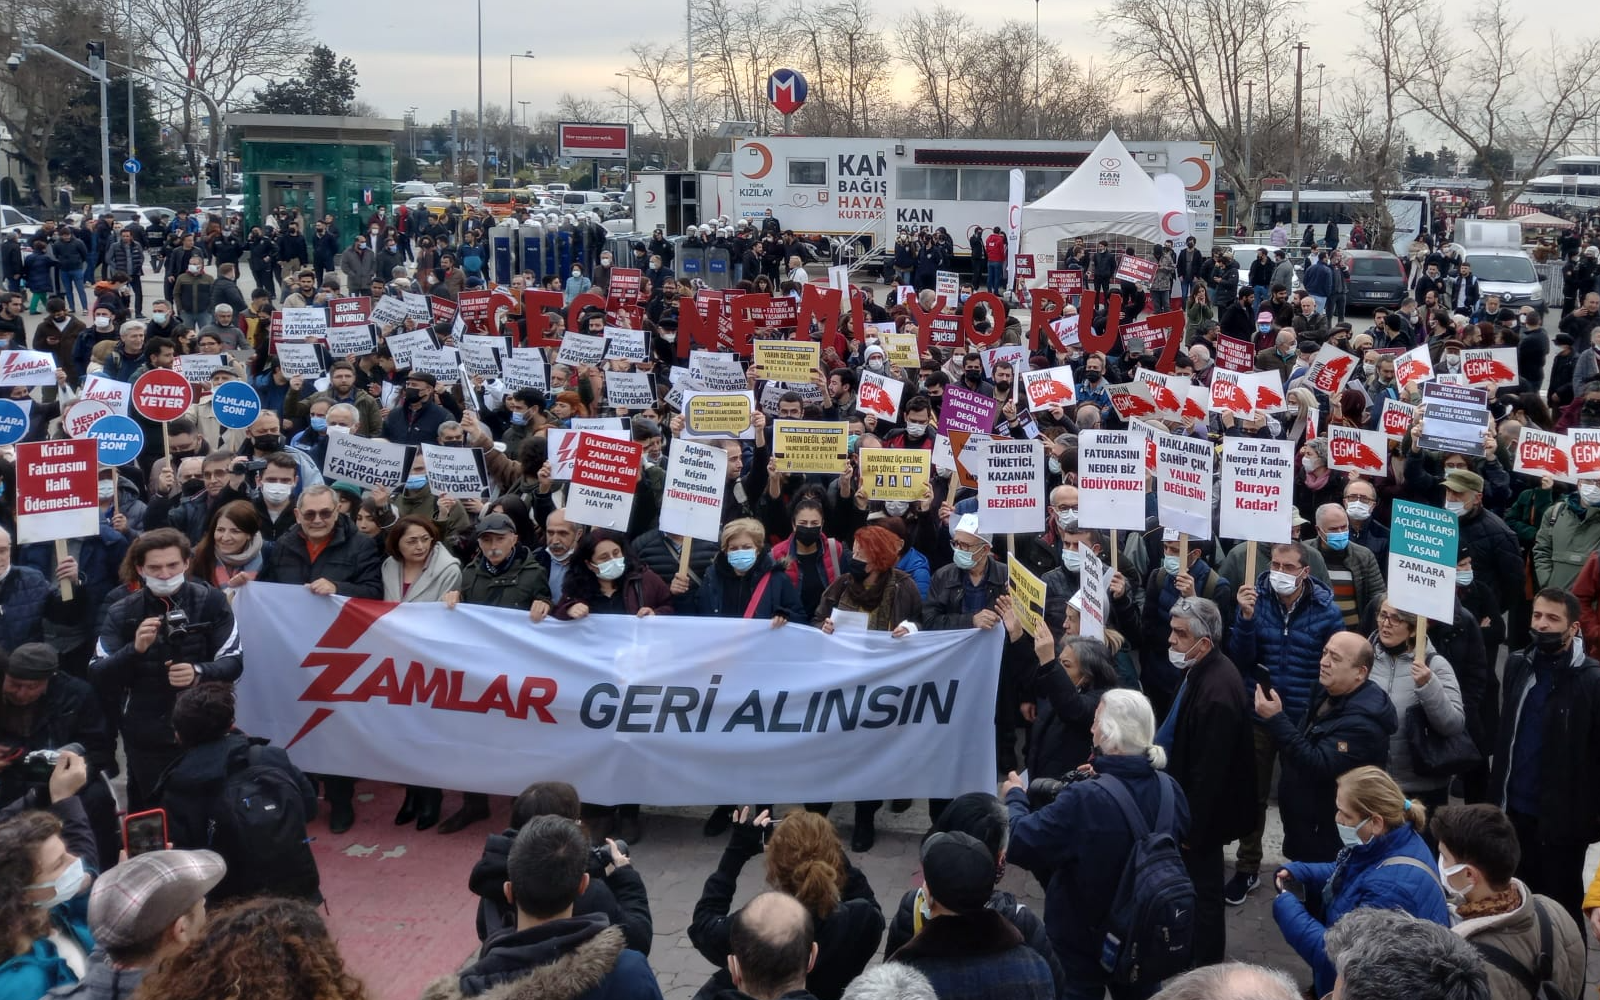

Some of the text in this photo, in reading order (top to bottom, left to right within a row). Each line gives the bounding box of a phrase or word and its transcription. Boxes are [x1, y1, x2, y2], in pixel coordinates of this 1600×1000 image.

[740, 189, 773, 197] KIZILAY
[838, 196, 886, 208] HAYA
[838, 210, 886, 220] KURTAR
[896, 208, 934, 222] KAN
[141, 384, 185, 396] ARTIK
[140, 396, 184, 408] YETER
[215, 394, 257, 409] ZAMLARA
[948, 388, 994, 408] GÜÇLÜ OLAN
[222, 406, 246, 416] SON!
[950, 399, 989, 417] ŞİRKETLERİ
[957, 411, 978, 424] DEĞİL
[90, 432, 140, 442] ZAMLARA
[804, 435, 820, 444] DEĞİL
[822, 436, 838, 445] ŞİMDİ
[1096, 433, 1128, 444] KRİZİN
[40, 442, 74, 458] Krizin
[100, 442, 127, 451] SON!
[585, 436, 636, 454] ÜLKEMİZDE
[989, 443, 1033, 454] TÜKENEN
[1160, 437, 1211, 457] HAKLARINA
[1238, 442, 1280, 453] Zam Zam
[588, 450, 628, 464] ZAMLAR,
[903, 455, 923, 463] KELİME
[1084, 449, 1140, 459] FATURASINI
[1226, 454, 1291, 468] Nereye Kadar,
[28, 461, 86, 476] Faturasını
[330, 456, 400, 479] FATURALARI
[577, 458, 616, 473] YAĞMUR
[618, 467, 636, 476] GİBİ
[679, 456, 716, 471] Sefaletin,
[988, 457, 1035, 468] TÜKETİCİ,
[1089, 463, 1136, 474] NEDEN BİZ
[1160, 452, 1208, 473] SAHİP ÇIK,
[429, 471, 479, 482] FATURALARI
[685, 469, 707, 480] Krizin
[988, 471, 1034, 481] KAZANAN
[1170, 468, 1200, 484] YALNIZ
[1234, 467, 1256, 477] Yetti
[45, 477, 70, 492] Halk
[431, 480, 481, 492] YAKIYORUZ
[672, 478, 717, 494] Pençesinde
[995, 484, 1028, 495] TEFECİ
[1081, 477, 1142, 490] ÖDÜYORUZ!
[1235, 481, 1280, 497] Buraya
[579, 488, 622, 502] ZAMLARA
[667, 488, 720, 507] TÜKENİYORUZ!
[1164, 482, 1206, 501] DEĞİLSİN!
[24, 494, 92, 512] Ödemesin...
[585, 499, 613, 509] HAYIR
[988, 495, 1036, 508] BEZİRGAN
[1236, 497, 1278, 512] Kadar!
[1397, 504, 1454, 524] YOKSULLUĞA
[1394, 516, 1455, 537] AÇLIĞA KARŞI
[1404, 529, 1444, 547] İNSANCA
[1407, 543, 1440, 558] YAŞAM
[1399, 560, 1445, 578] ZAMLARA
[1408, 573, 1436, 588] HAYIR
[296, 637, 960, 733] ZAMLAR GERİ ALINSIN
